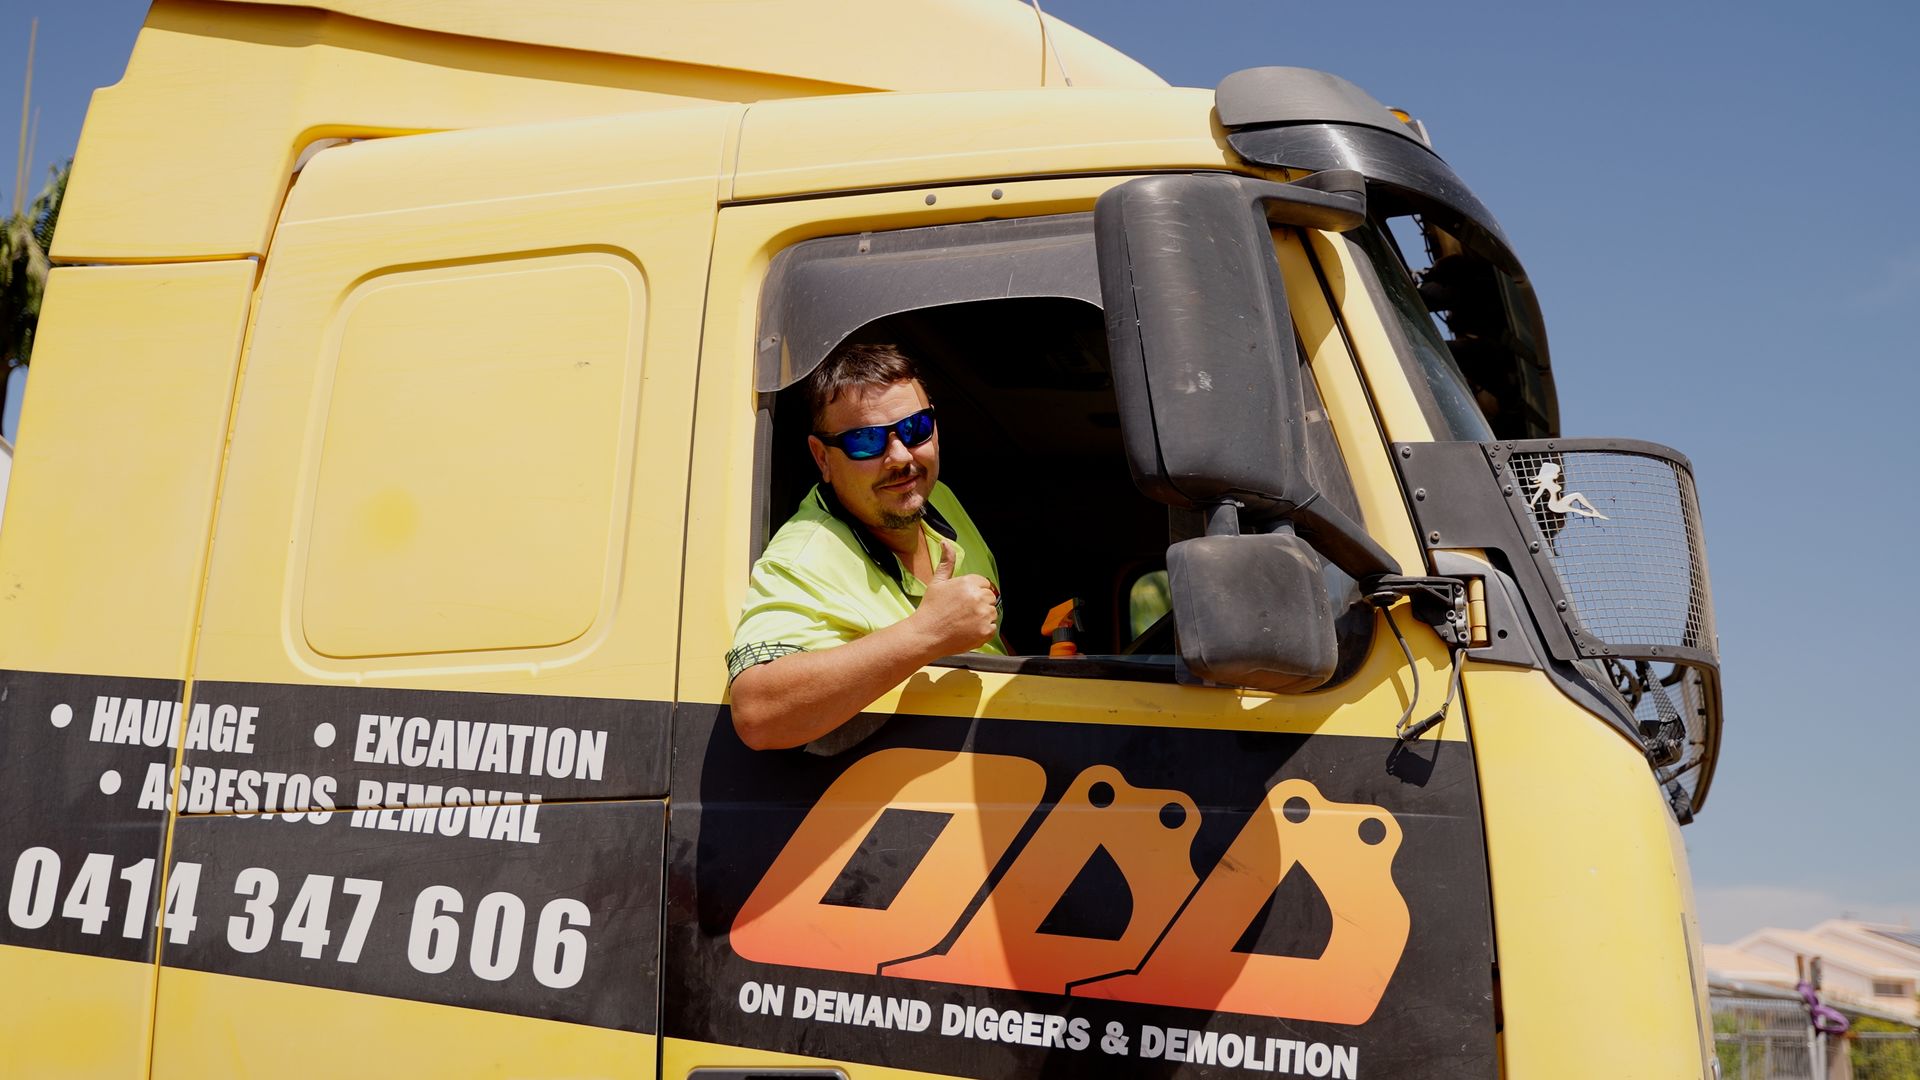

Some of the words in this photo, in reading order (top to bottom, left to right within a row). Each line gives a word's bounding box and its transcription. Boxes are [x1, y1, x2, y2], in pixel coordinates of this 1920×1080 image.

[354, 714, 608, 781] EXCAVATION
[137, 762, 338, 825] ASBESTOS
[350, 780, 543, 844] REMOVAL
[8, 846, 203, 946] 0414
[226, 867, 383, 964] 347
[407, 885, 592, 989] 606
[738, 981, 785, 1017] ON
[793, 988, 932, 1033] DEMAND
[940, 1004, 1092, 1052] DIGGERS
[1101, 1022, 1130, 1057] &
[1140, 1026, 1359, 1079] DEMOLITION
